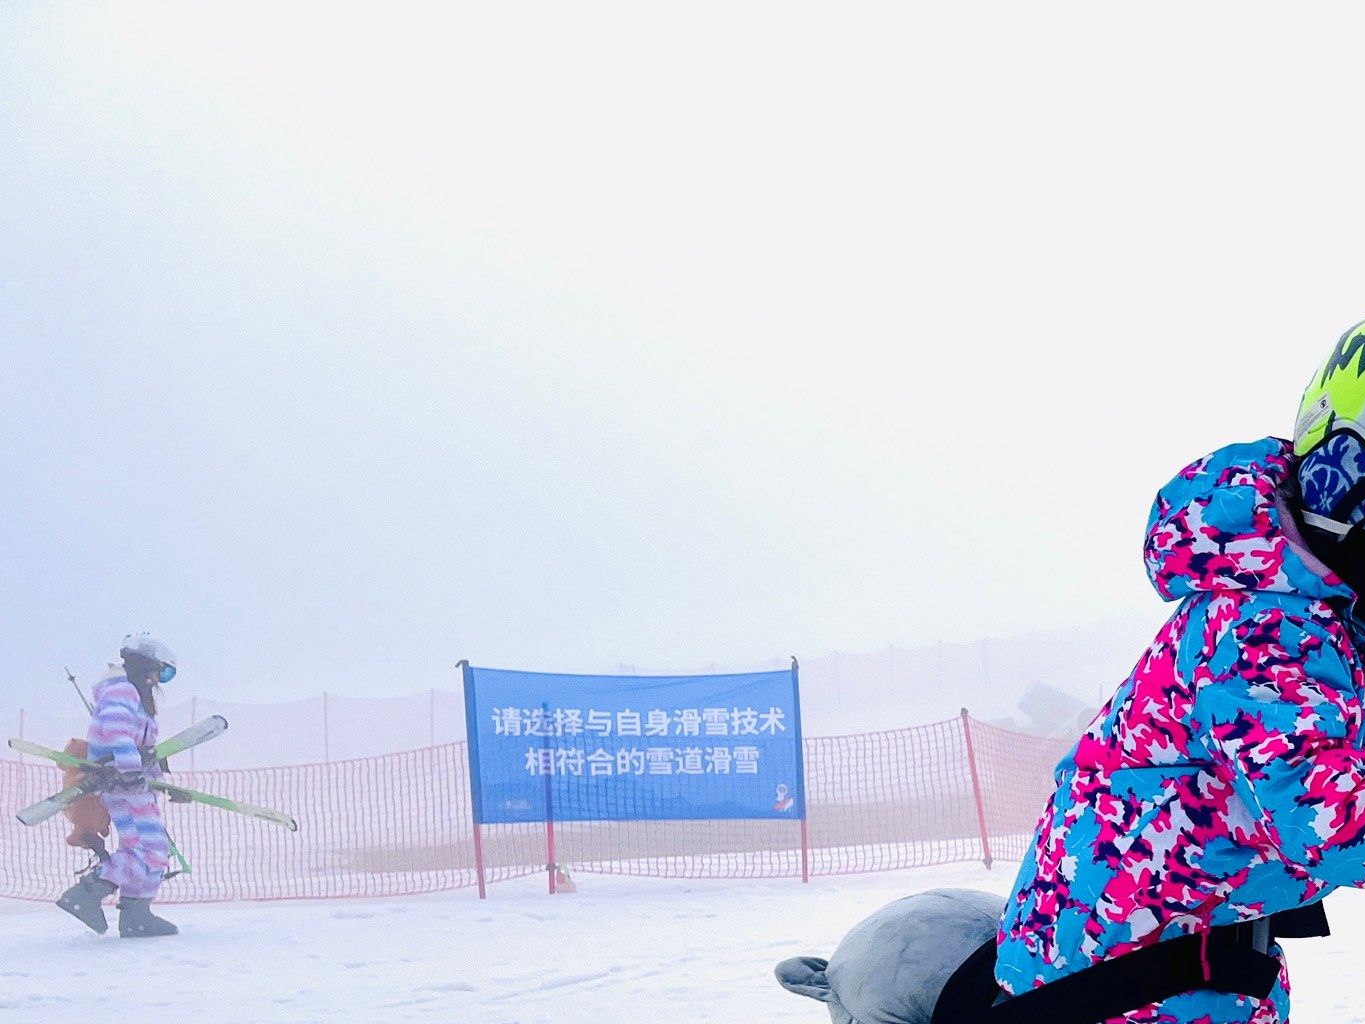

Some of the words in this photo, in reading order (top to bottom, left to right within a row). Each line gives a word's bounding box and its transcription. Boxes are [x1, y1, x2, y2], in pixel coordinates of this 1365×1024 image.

[491, 707, 786, 737] 请选择与自身滑雪技术
[524, 747, 760, 776] 相符合的雪道滑雪
